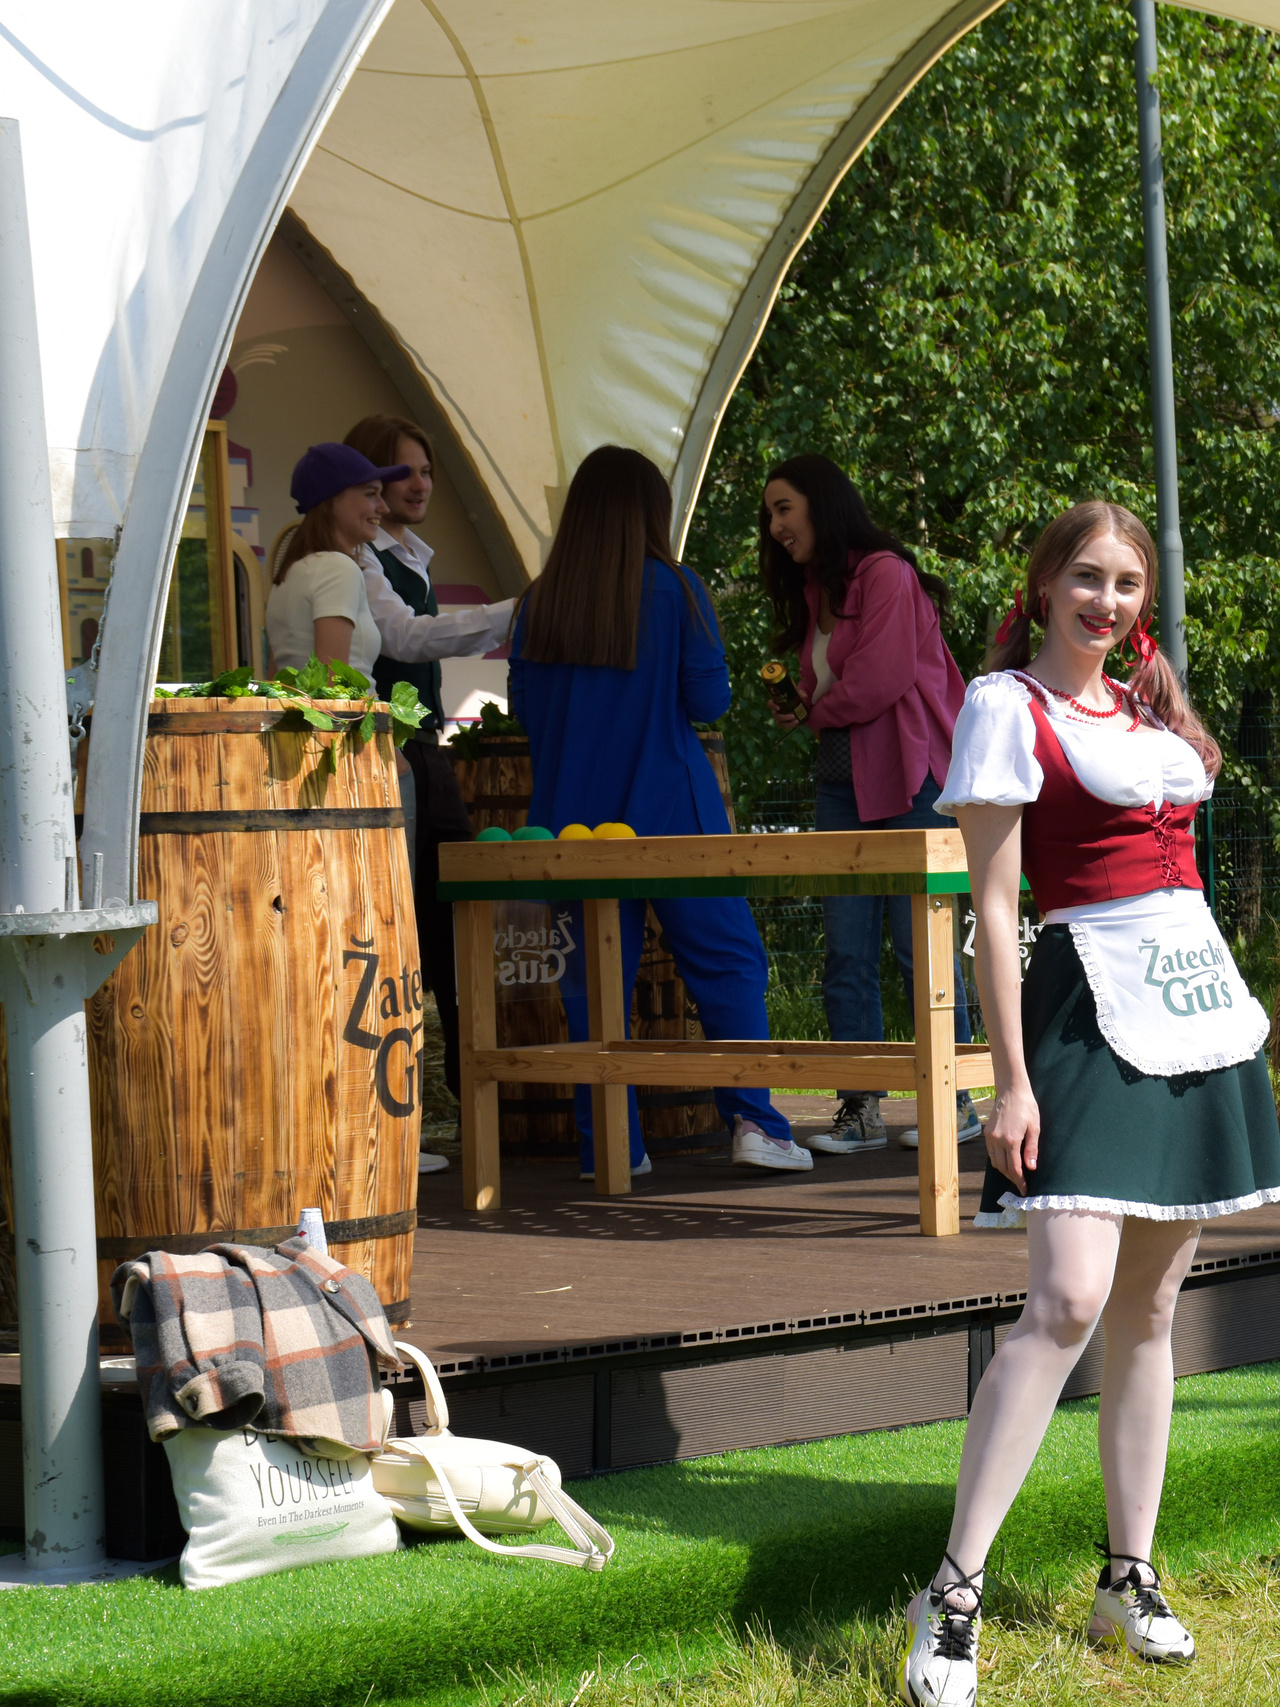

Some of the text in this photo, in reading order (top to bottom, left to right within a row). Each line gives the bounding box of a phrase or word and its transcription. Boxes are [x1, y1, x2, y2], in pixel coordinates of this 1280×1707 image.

[1162, 975, 1233, 1017] Gus
[250, 1459, 356, 1509] YOURSELF
[258, 1500, 365, 1527] Even In The Darkest Moments
